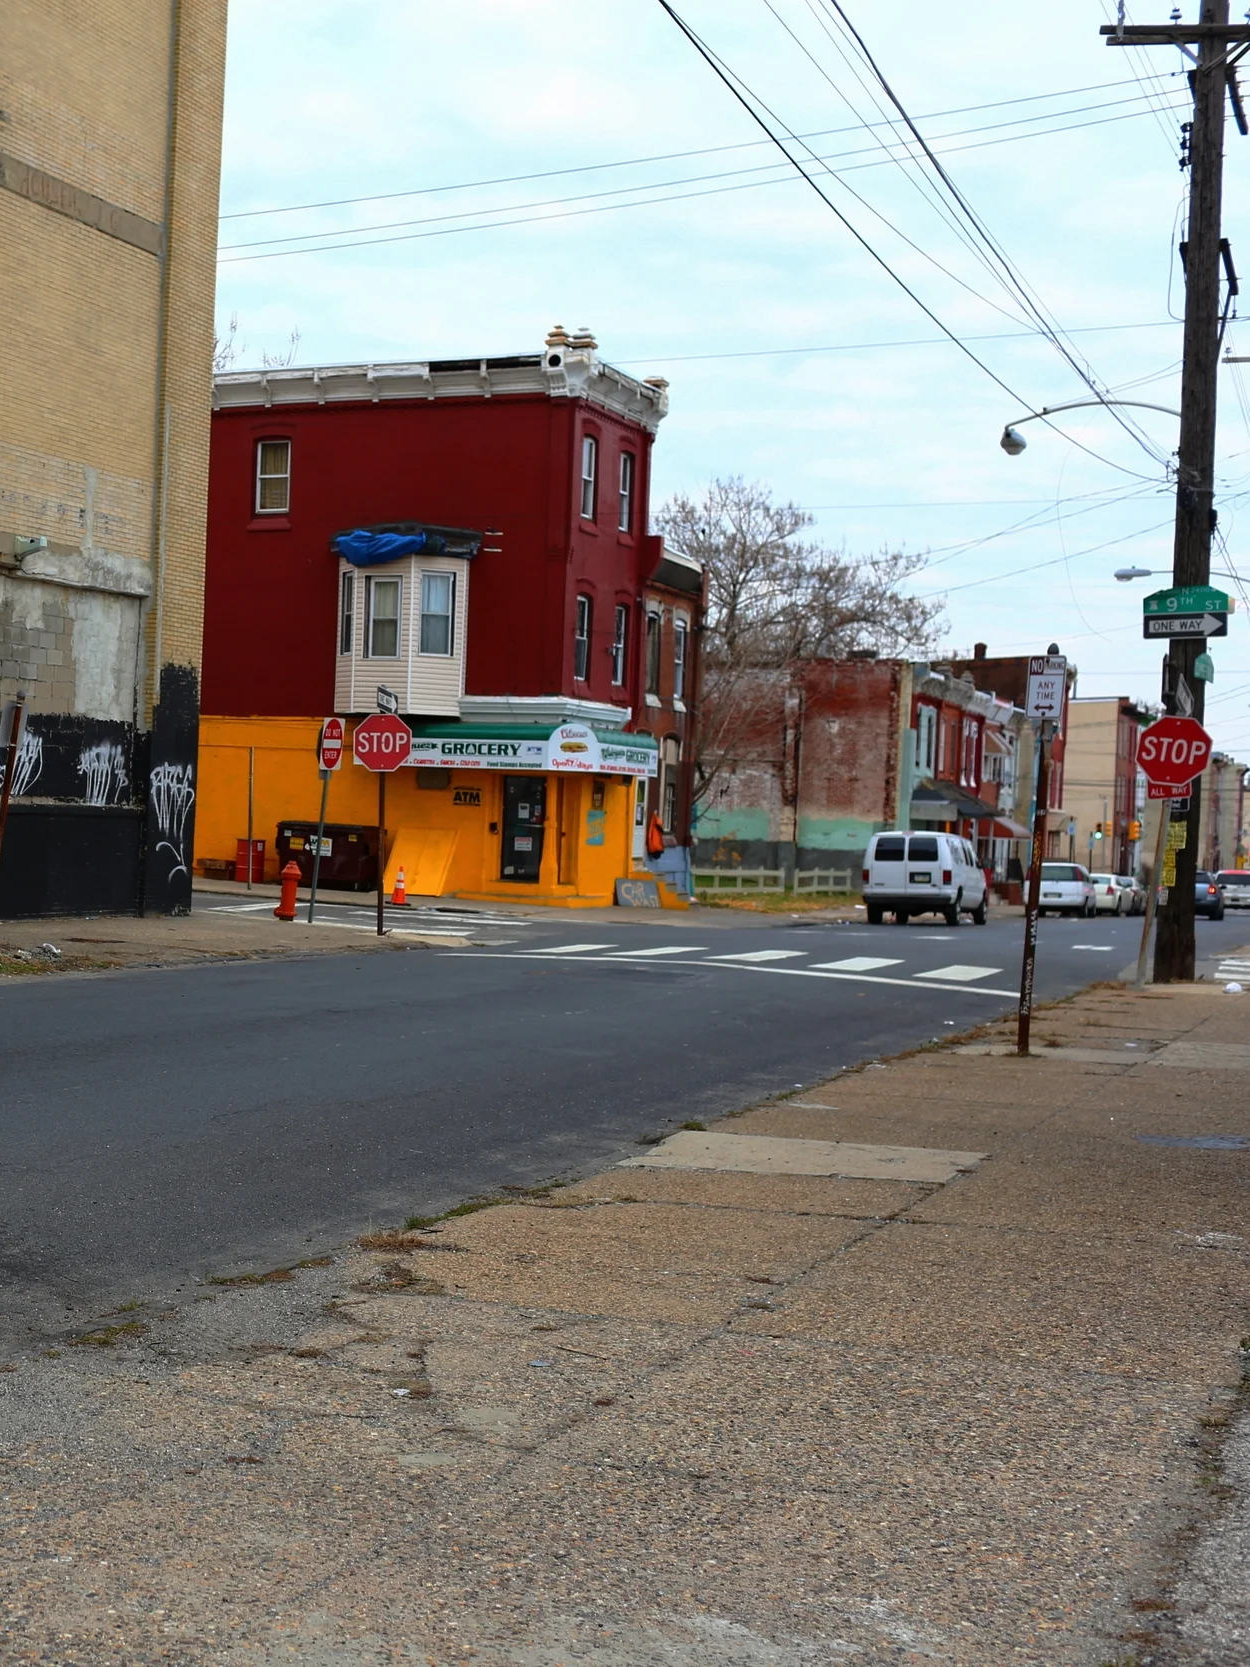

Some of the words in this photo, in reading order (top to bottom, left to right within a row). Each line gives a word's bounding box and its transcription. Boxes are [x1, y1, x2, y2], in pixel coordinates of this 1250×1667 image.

[1205, 600, 1222, 610] ST
[1153, 621, 1175, 631] ONE
[1179, 619, 1203, 630] WAY
[1031, 660, 1043, 673] NO
[1044, 660, 1065, 670] ARKING
[1038, 681, 1055, 690] ANY
[1036, 691, 1055, 700] TIME
[325, 728, 331, 737] DO
[333, 728, 341, 737] NOT
[358, 732, 407, 753] STOP
[324, 750, 338, 759] ENTER
[441, 742, 522, 756] GROCERY
[1142, 736, 1206, 765] STOP
[519, 761, 542, 769] Accepted
[1150, 787, 1165, 796] ALL
[1171, 785, 1188, 795] WAY
[453, 791, 480, 803] ATM
